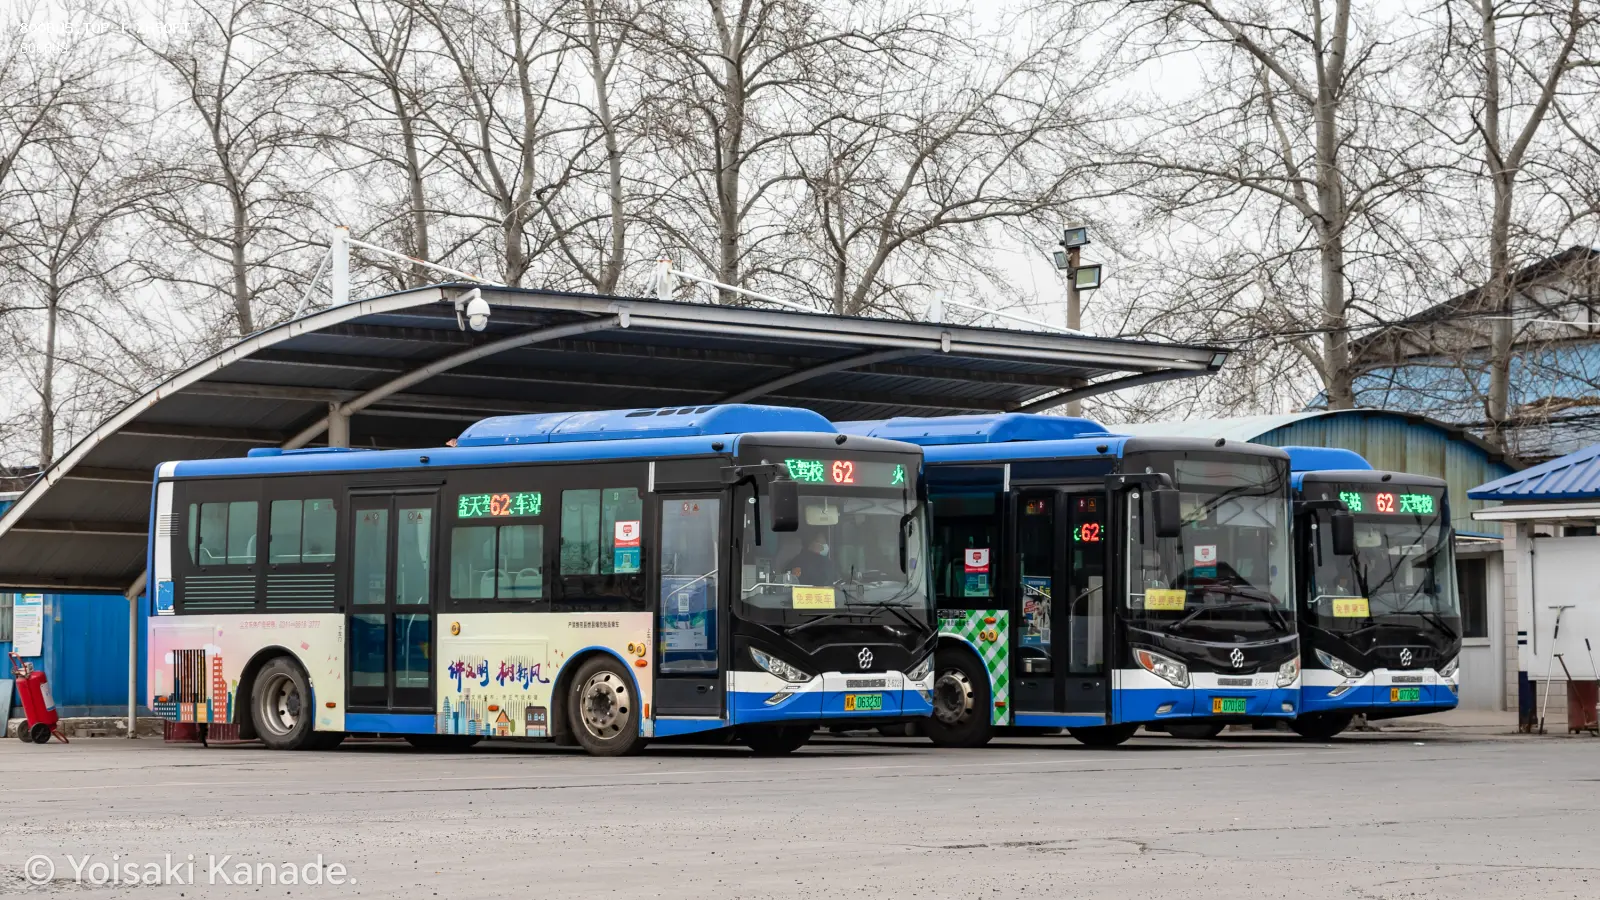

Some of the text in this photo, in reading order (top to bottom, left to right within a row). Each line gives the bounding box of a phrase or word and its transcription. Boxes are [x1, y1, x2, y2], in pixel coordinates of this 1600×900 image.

[832, 460, 854, 483] 62
[490, 493, 510, 516] 62
[1376, 493, 1394, 512] 62
[1081, 523, 1100, 542] 62
[796, 593, 833, 605] 免费乘车
[447, 659, 551, 693] 讲文明 树新风
